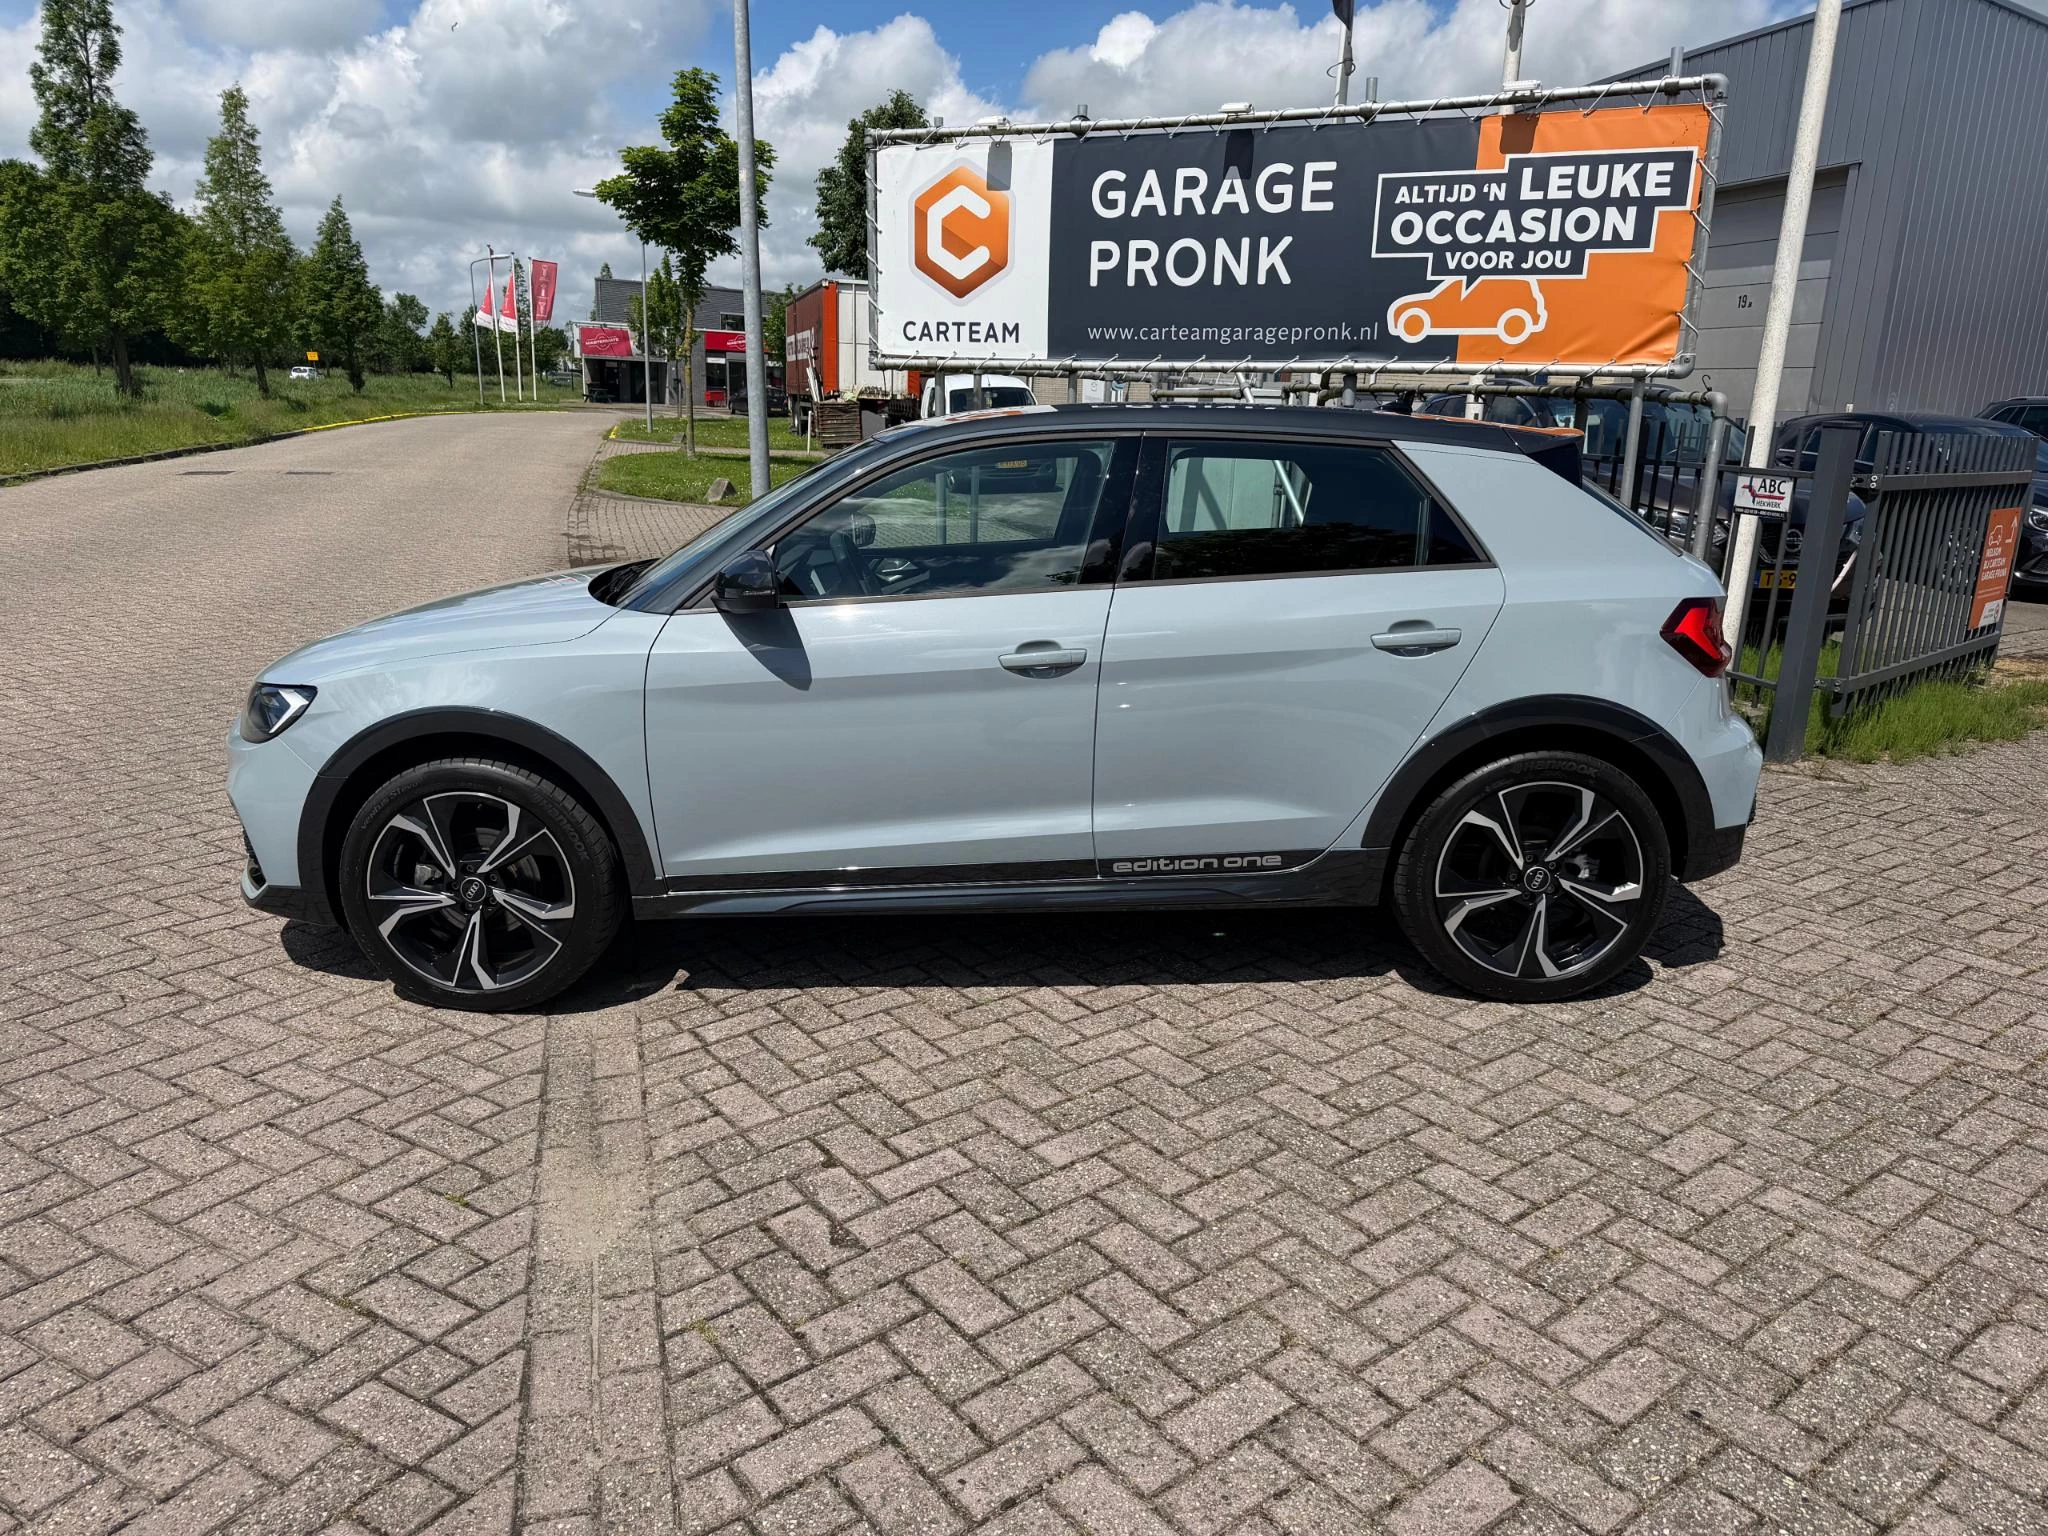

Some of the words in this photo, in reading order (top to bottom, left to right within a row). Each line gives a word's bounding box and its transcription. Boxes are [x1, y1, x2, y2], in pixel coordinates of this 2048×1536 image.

[1091, 161, 1339, 220] GARAGE
[1394, 183, 1477, 204] ALTIJD
[1519, 161, 1675, 201] LEUKE
[1390, 205, 1638, 246] OCCASION
[1089, 234, 1294, 288] PRONK
[1445, 250, 1515, 270] VOOR
[1520, 249, 1572, 269] JOU
[901, 320, 1020, 344] CARTEAM
[1086, 321, 1380, 346] www.carteamgaragepronk.nl
[1757, 478, 1787, 495] ABC
[1112, 858, 1219, 873] edition
[1223, 854, 1282, 868] one
